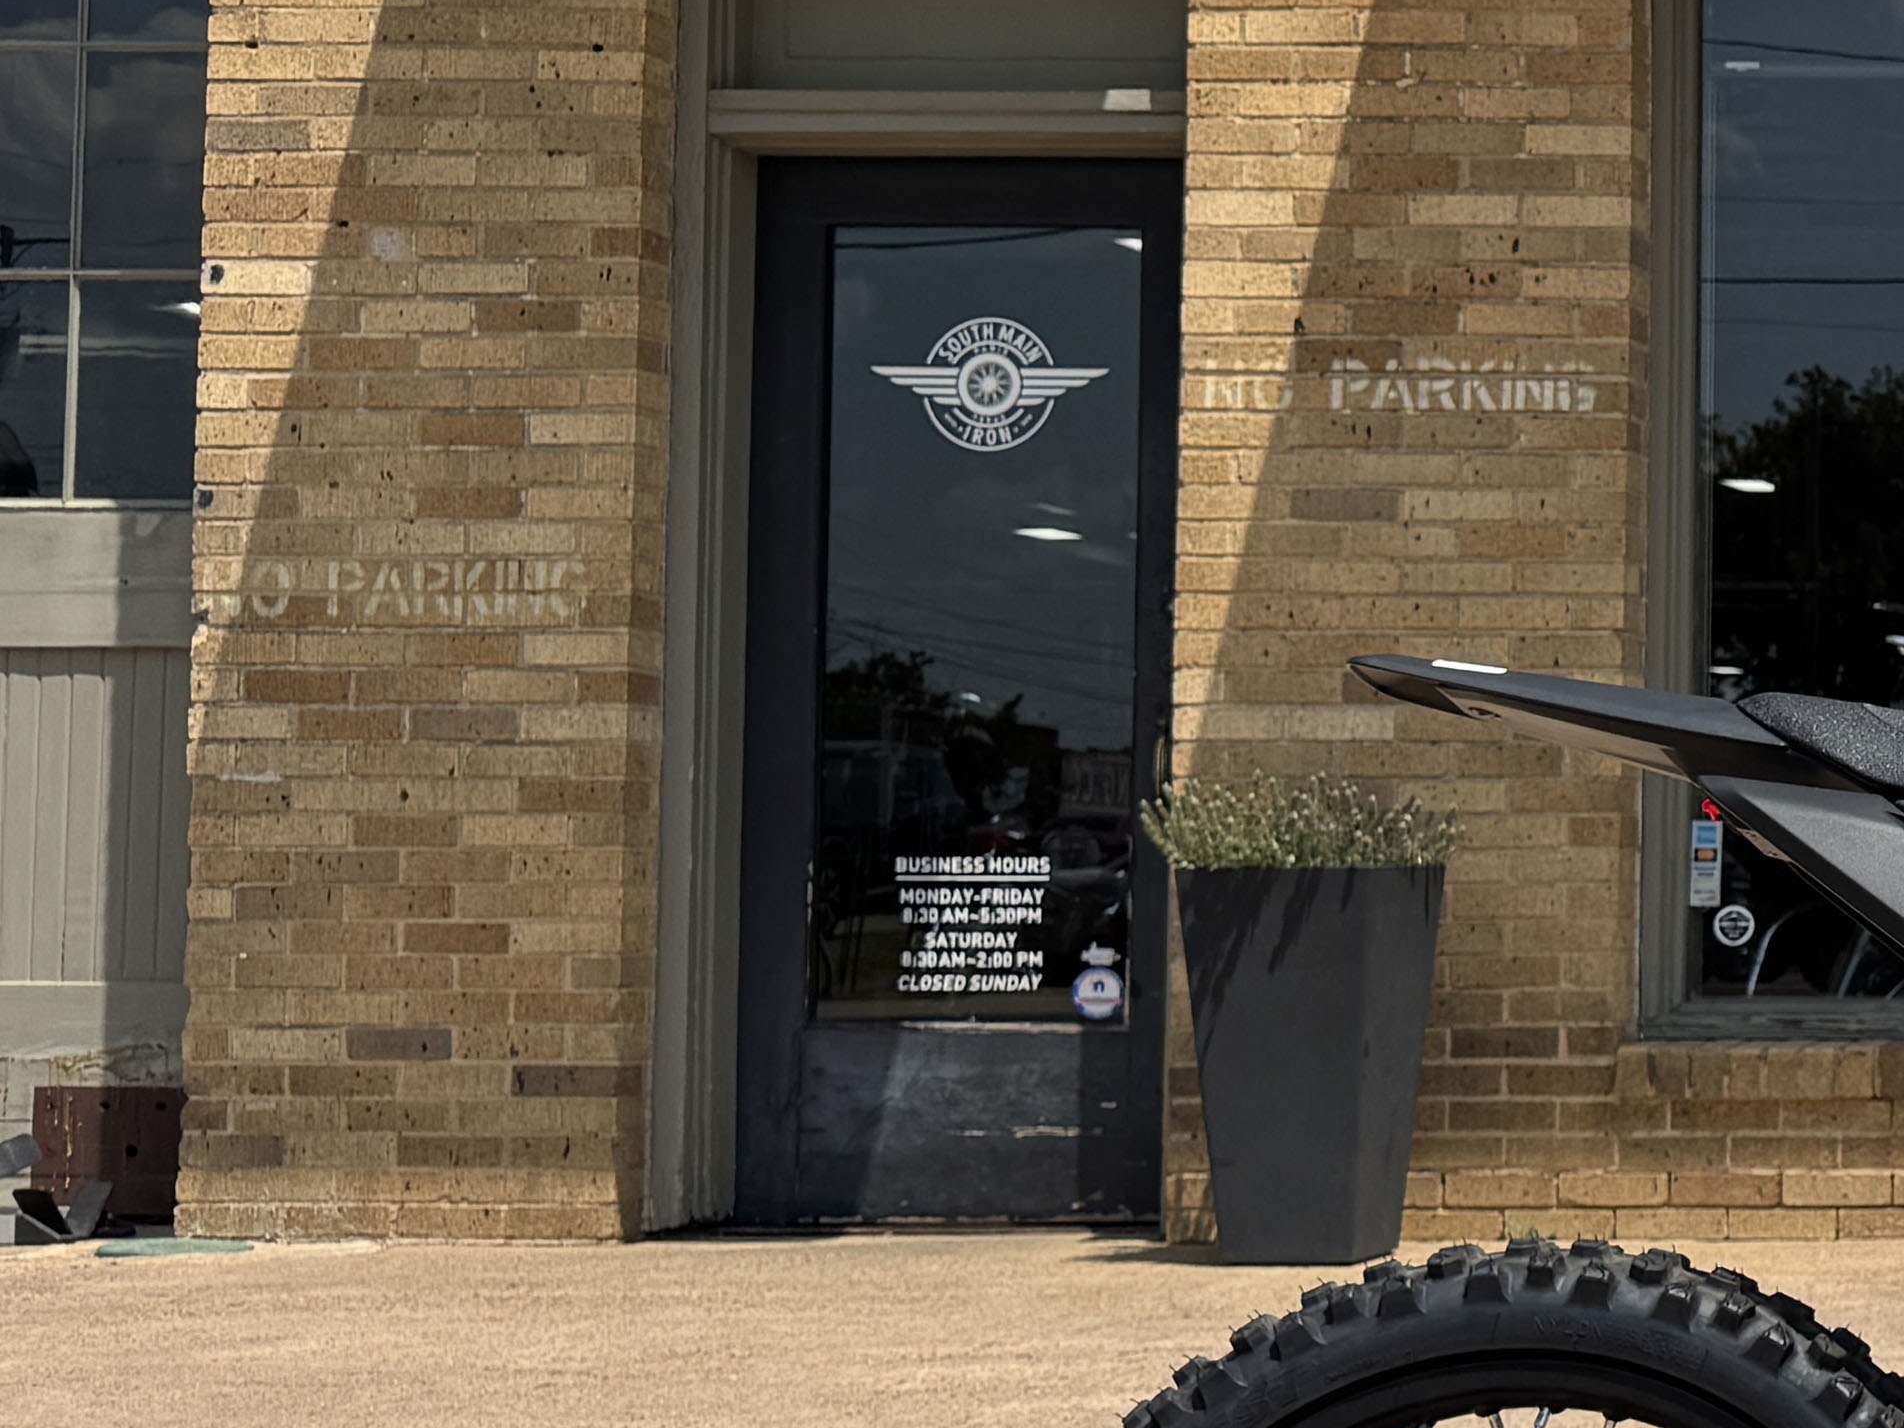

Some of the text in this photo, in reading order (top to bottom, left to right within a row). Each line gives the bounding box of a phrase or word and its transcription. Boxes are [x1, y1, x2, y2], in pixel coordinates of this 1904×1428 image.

[939, 323, 1043, 364] SOUTH MAIN
[1331, 358, 1597, 410] PARKING
[962, 425, 1012, 445] IRON
[328, 560, 587, 617] PARKING
[895, 856, 1050, 873] BUSINESS HOURS
[900, 888, 1044, 905] MONDAY-FRIDAY
[924, 931, 1018, 949] SATURDAY
[898, 973, 1043, 991] CLOSED SUNDAY
